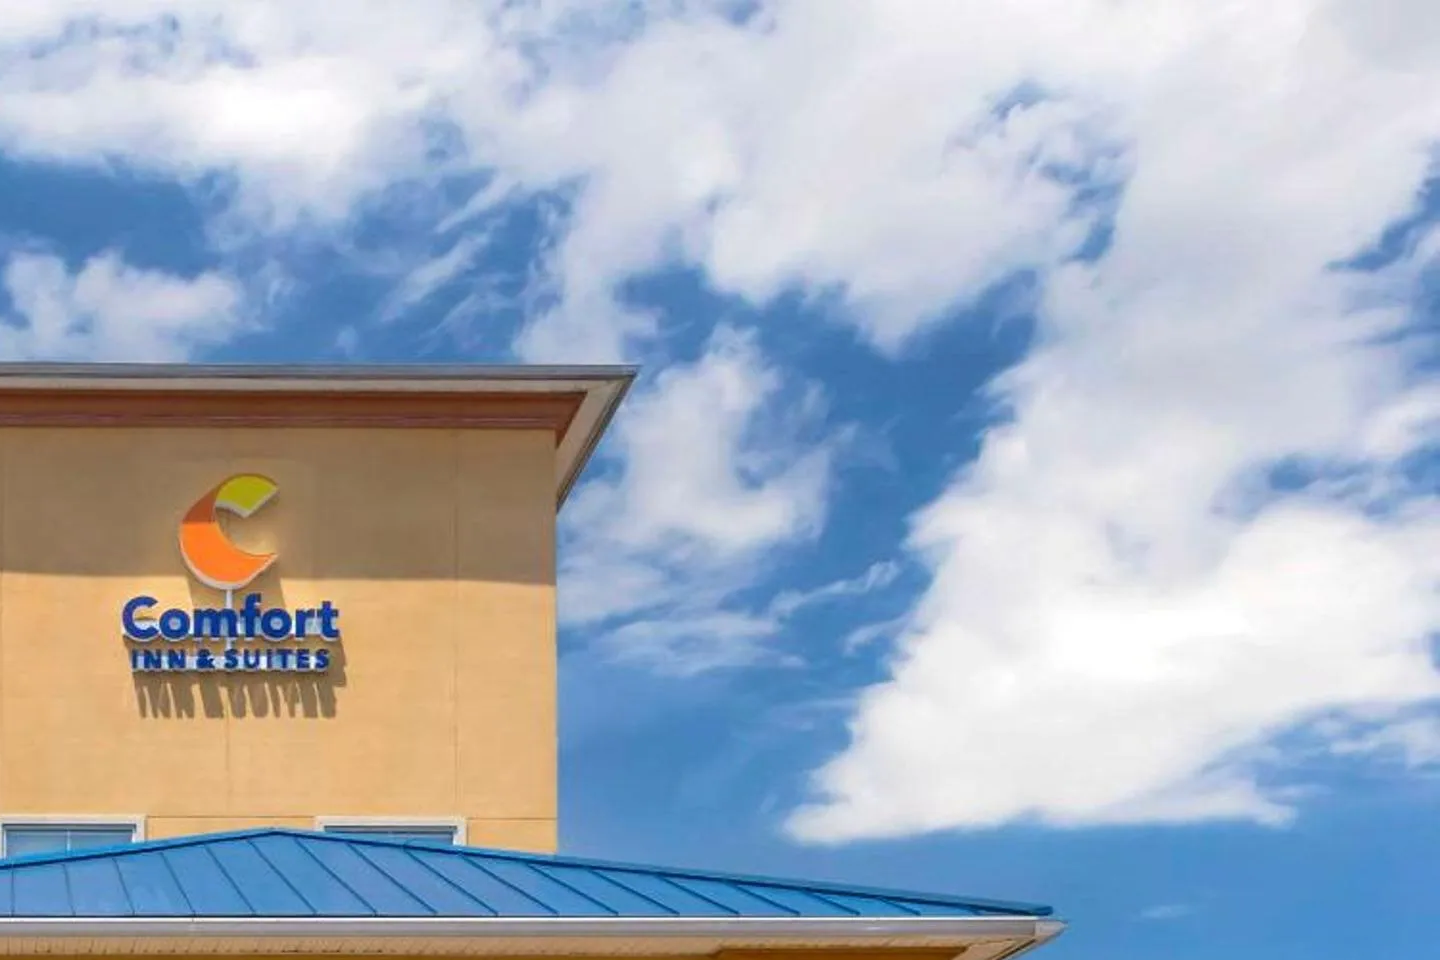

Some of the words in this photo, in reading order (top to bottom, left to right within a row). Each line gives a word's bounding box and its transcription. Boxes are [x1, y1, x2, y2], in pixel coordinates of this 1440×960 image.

[122, 593, 340, 640] Comfort
[131, 648, 186, 671] INN
[195, 648, 215, 671] &
[224, 648, 330, 671] SUITES
